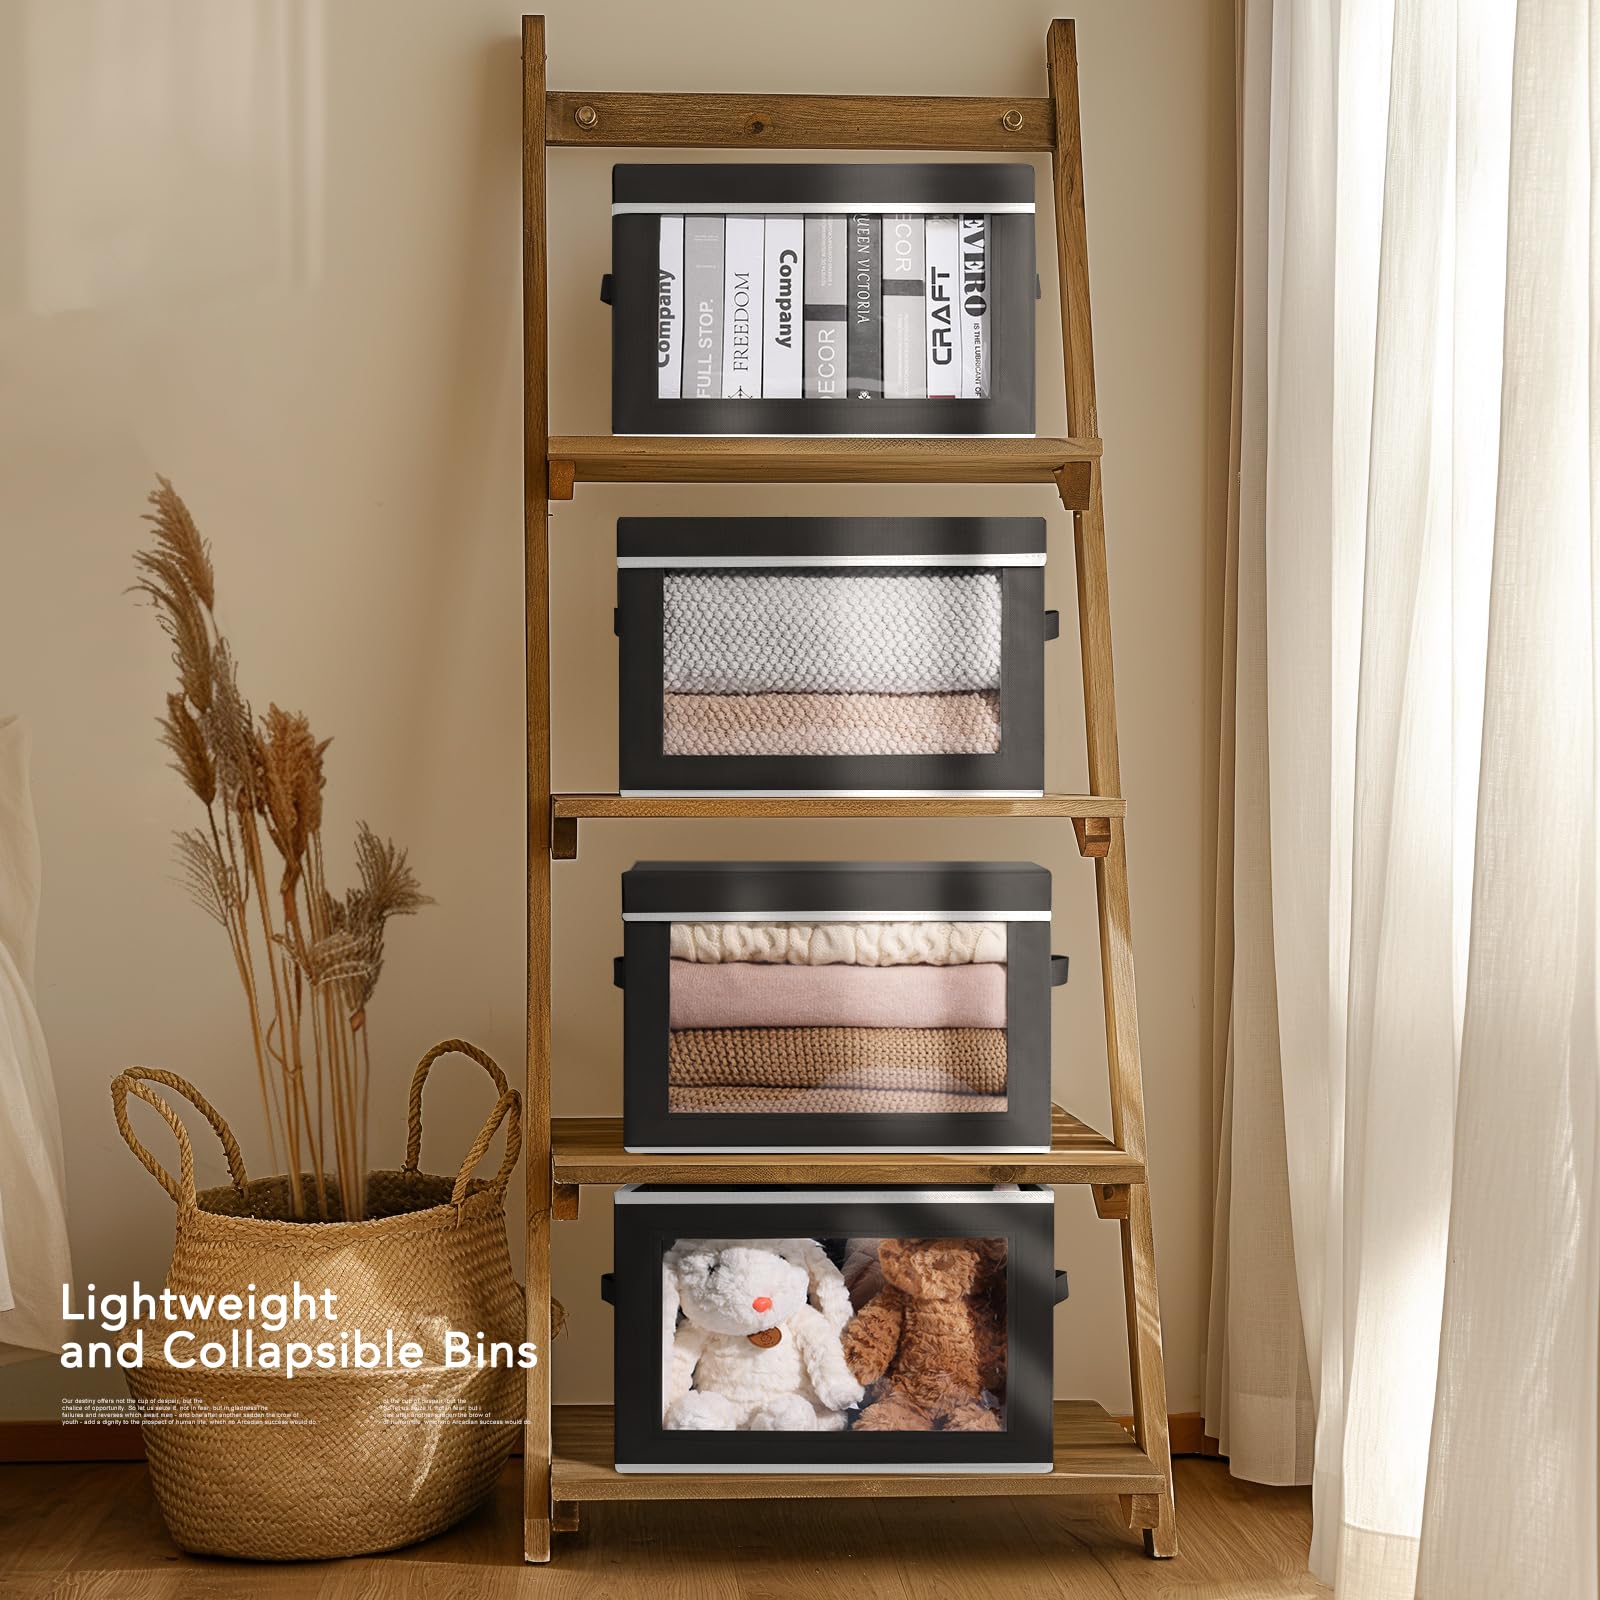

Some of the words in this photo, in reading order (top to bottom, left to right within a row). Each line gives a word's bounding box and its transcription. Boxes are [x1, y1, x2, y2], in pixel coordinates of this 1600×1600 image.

[699, 299, 714, 348] STOP.
[733, 272, 750, 372] FREEDOM
[775, 249, 798, 348] Company
[857, 259, 870, 324] VICTORIA
[931, 266, 952, 365] CRAFT
[697, 354, 712, 398] FULL
[975, 387, 982, 396] OF
